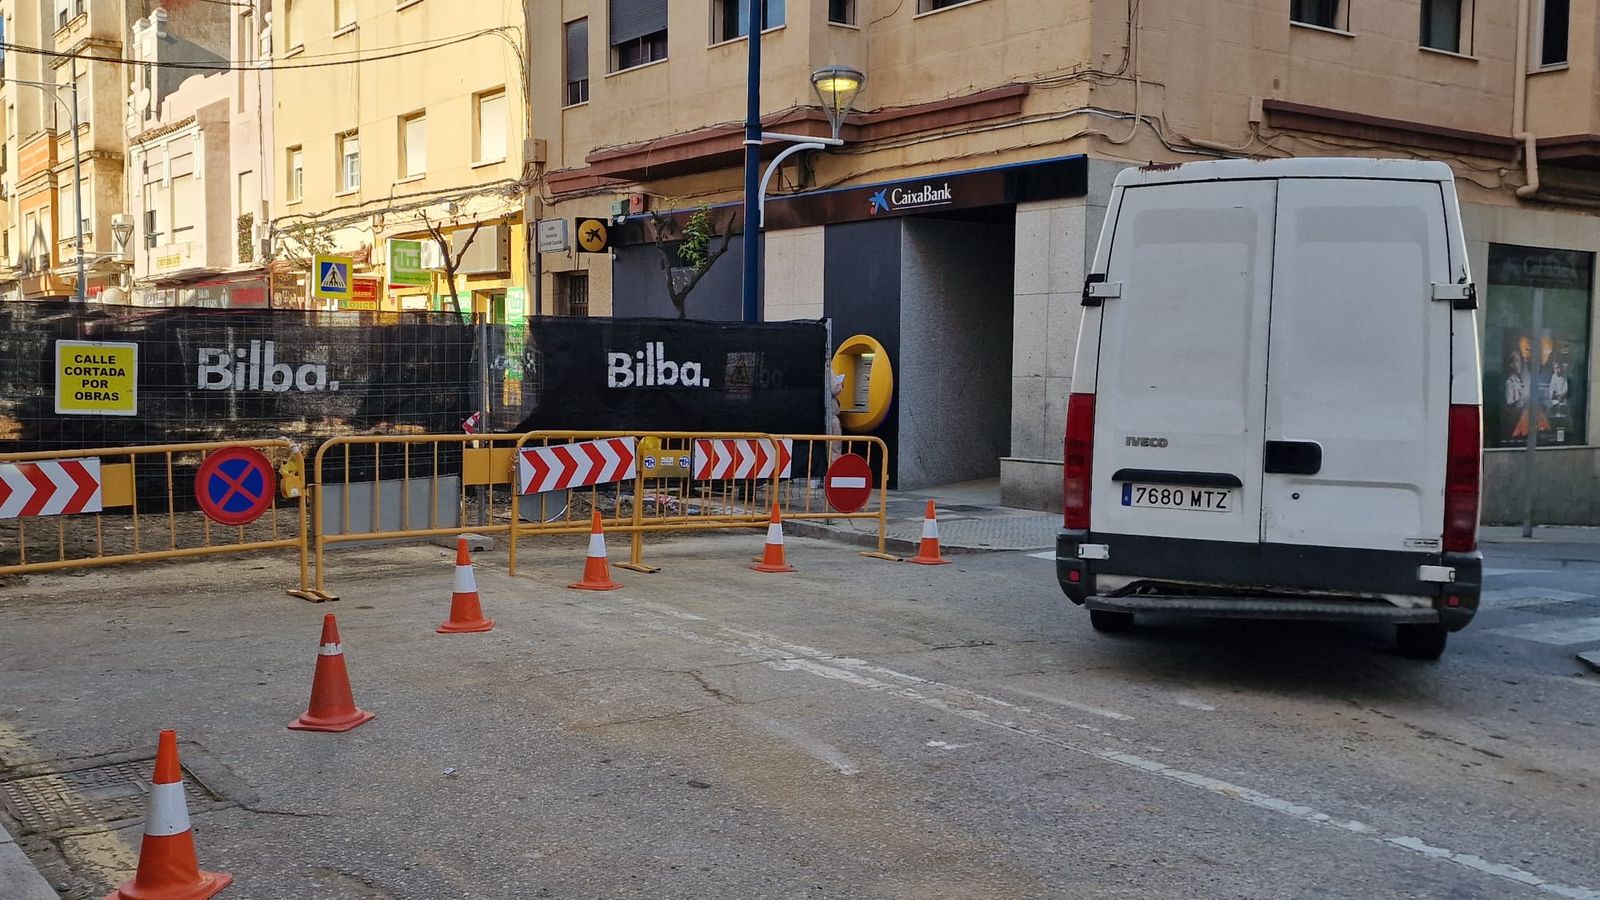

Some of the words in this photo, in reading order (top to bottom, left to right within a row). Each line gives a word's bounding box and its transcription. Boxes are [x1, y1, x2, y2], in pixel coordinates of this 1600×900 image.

[892, 183, 952, 206] CaixaBank
[349, 301, 375, 309] ONCE
[74, 354, 116, 365] CALLE
[607, 341, 711, 388] Bilba.
[64, 366, 126, 377] CORTADA
[197, 339, 340, 393] Bilba.
[81, 379, 109, 389] POR
[74, 391, 120, 401] OBRAS
[1125, 436, 1169, 449] IVECO
[1135, 487, 1184, 506] 7680
[1190, 490, 1228, 509] MTZ
